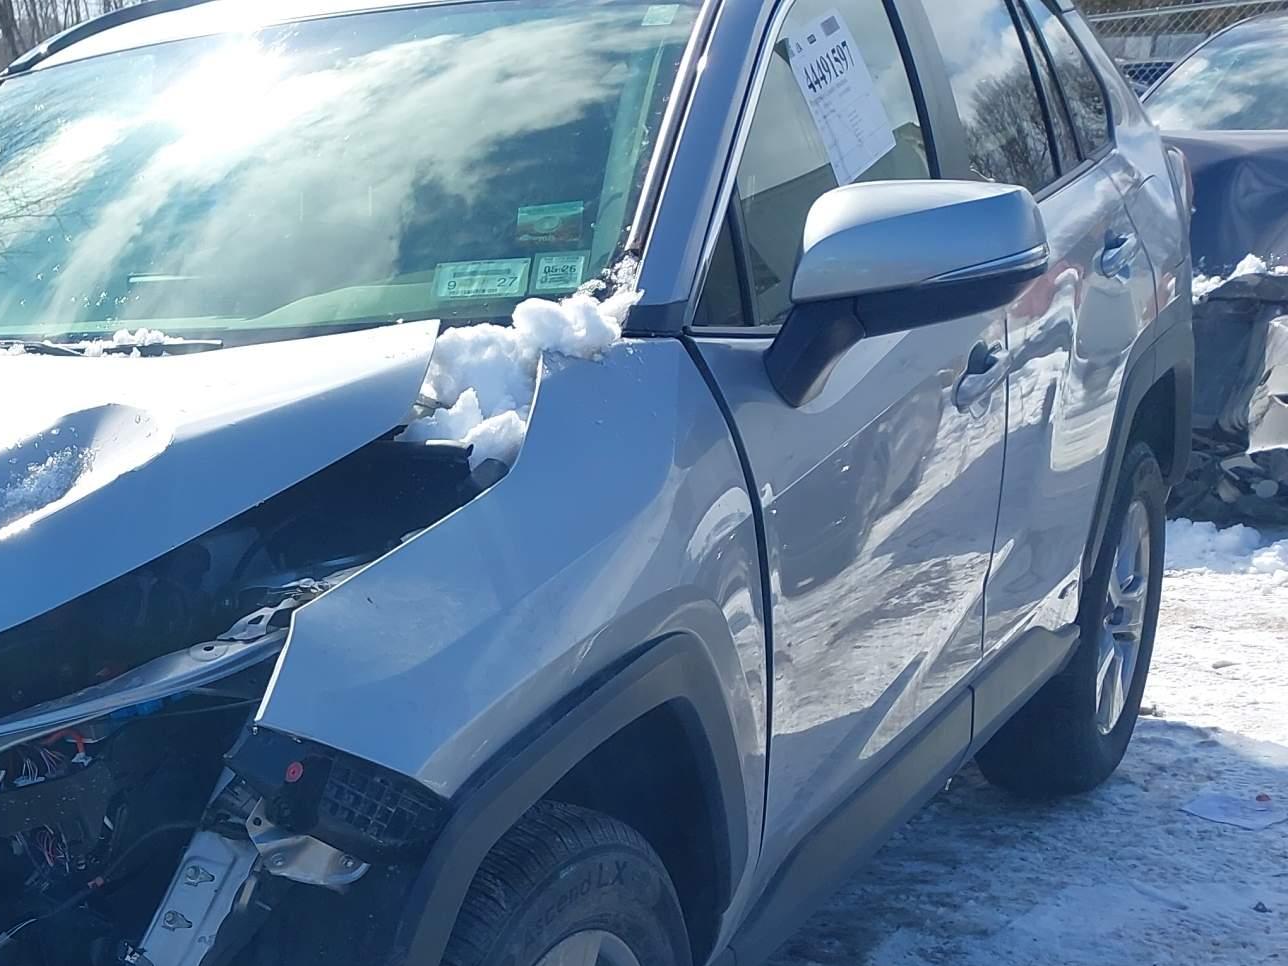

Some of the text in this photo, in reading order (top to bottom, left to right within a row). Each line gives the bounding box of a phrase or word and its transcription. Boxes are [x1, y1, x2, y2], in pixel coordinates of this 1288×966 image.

[803, 40, 854, 93] 44491597
[447, 276, 518, 291] 9 27
[596, 859, 628, 889] LX
